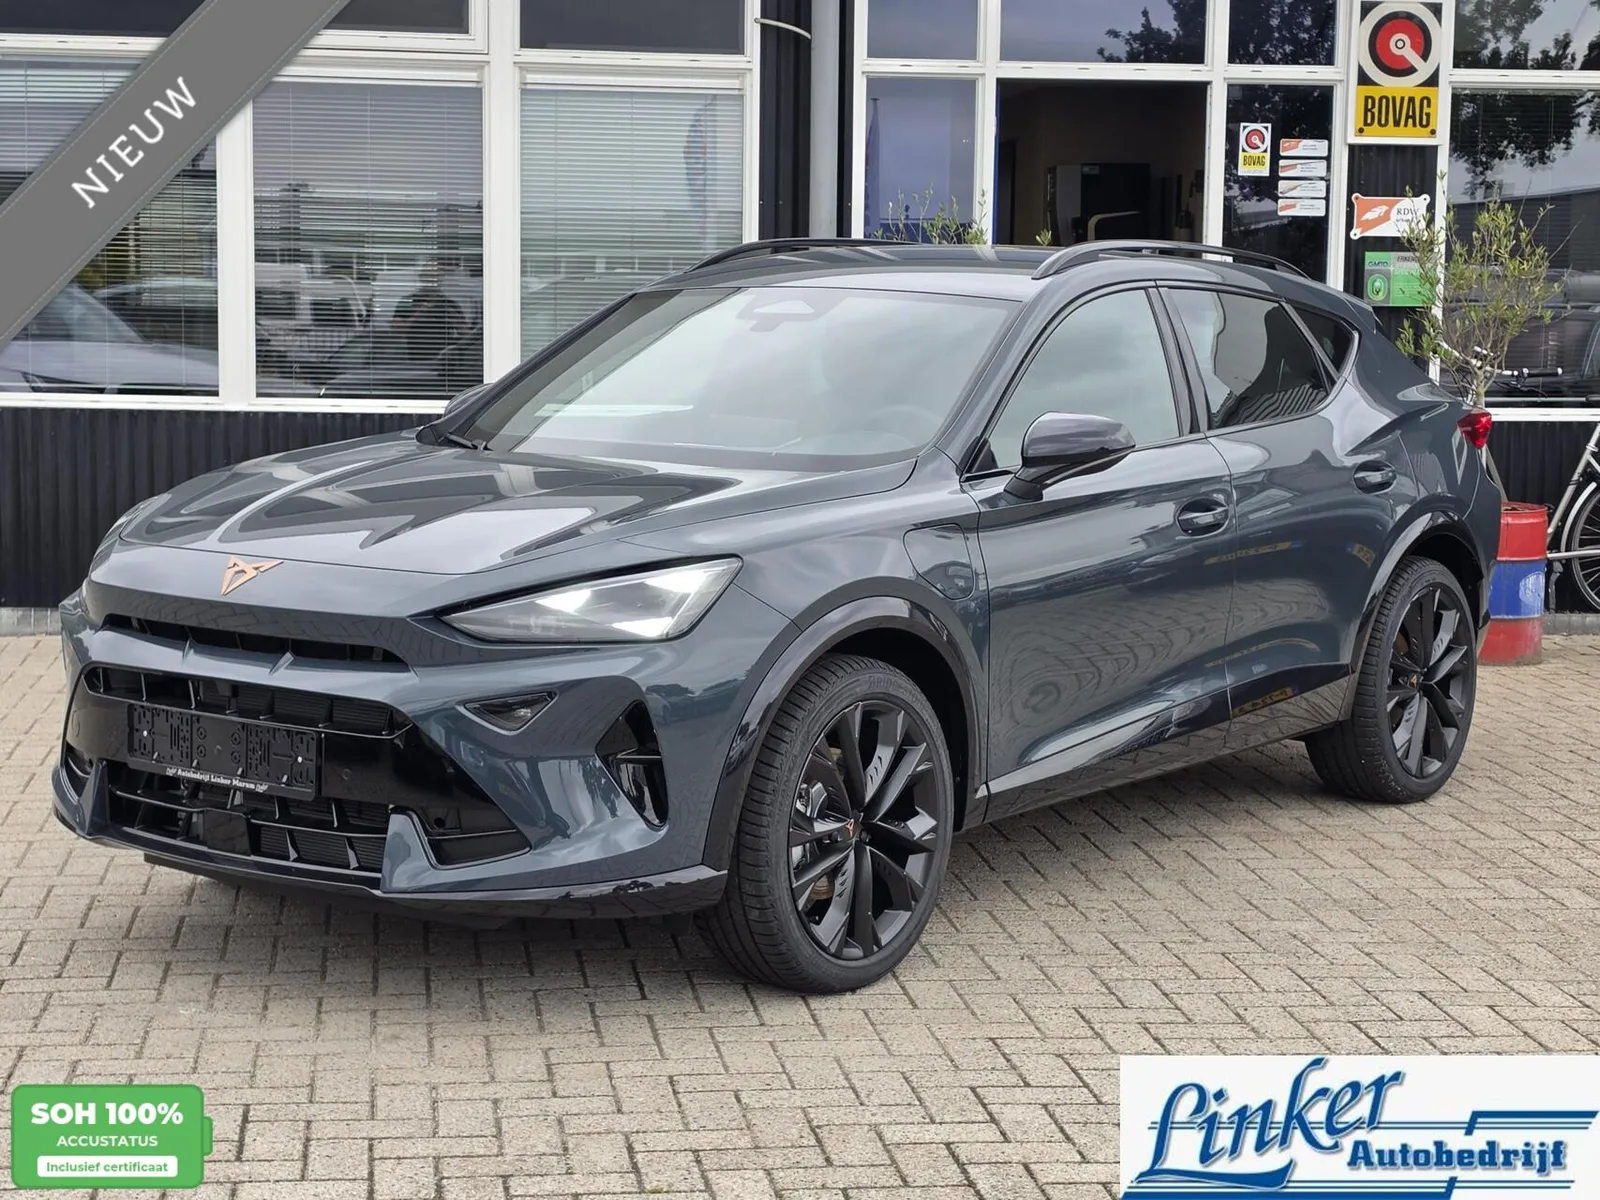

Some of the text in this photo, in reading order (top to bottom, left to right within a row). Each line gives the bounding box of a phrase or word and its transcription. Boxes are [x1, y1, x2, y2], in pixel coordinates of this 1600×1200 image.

[1363, 95, 1432, 128] BOVAG
[1243, 155, 1266, 166] BOVAG
[1396, 207, 1419, 216] RDW
